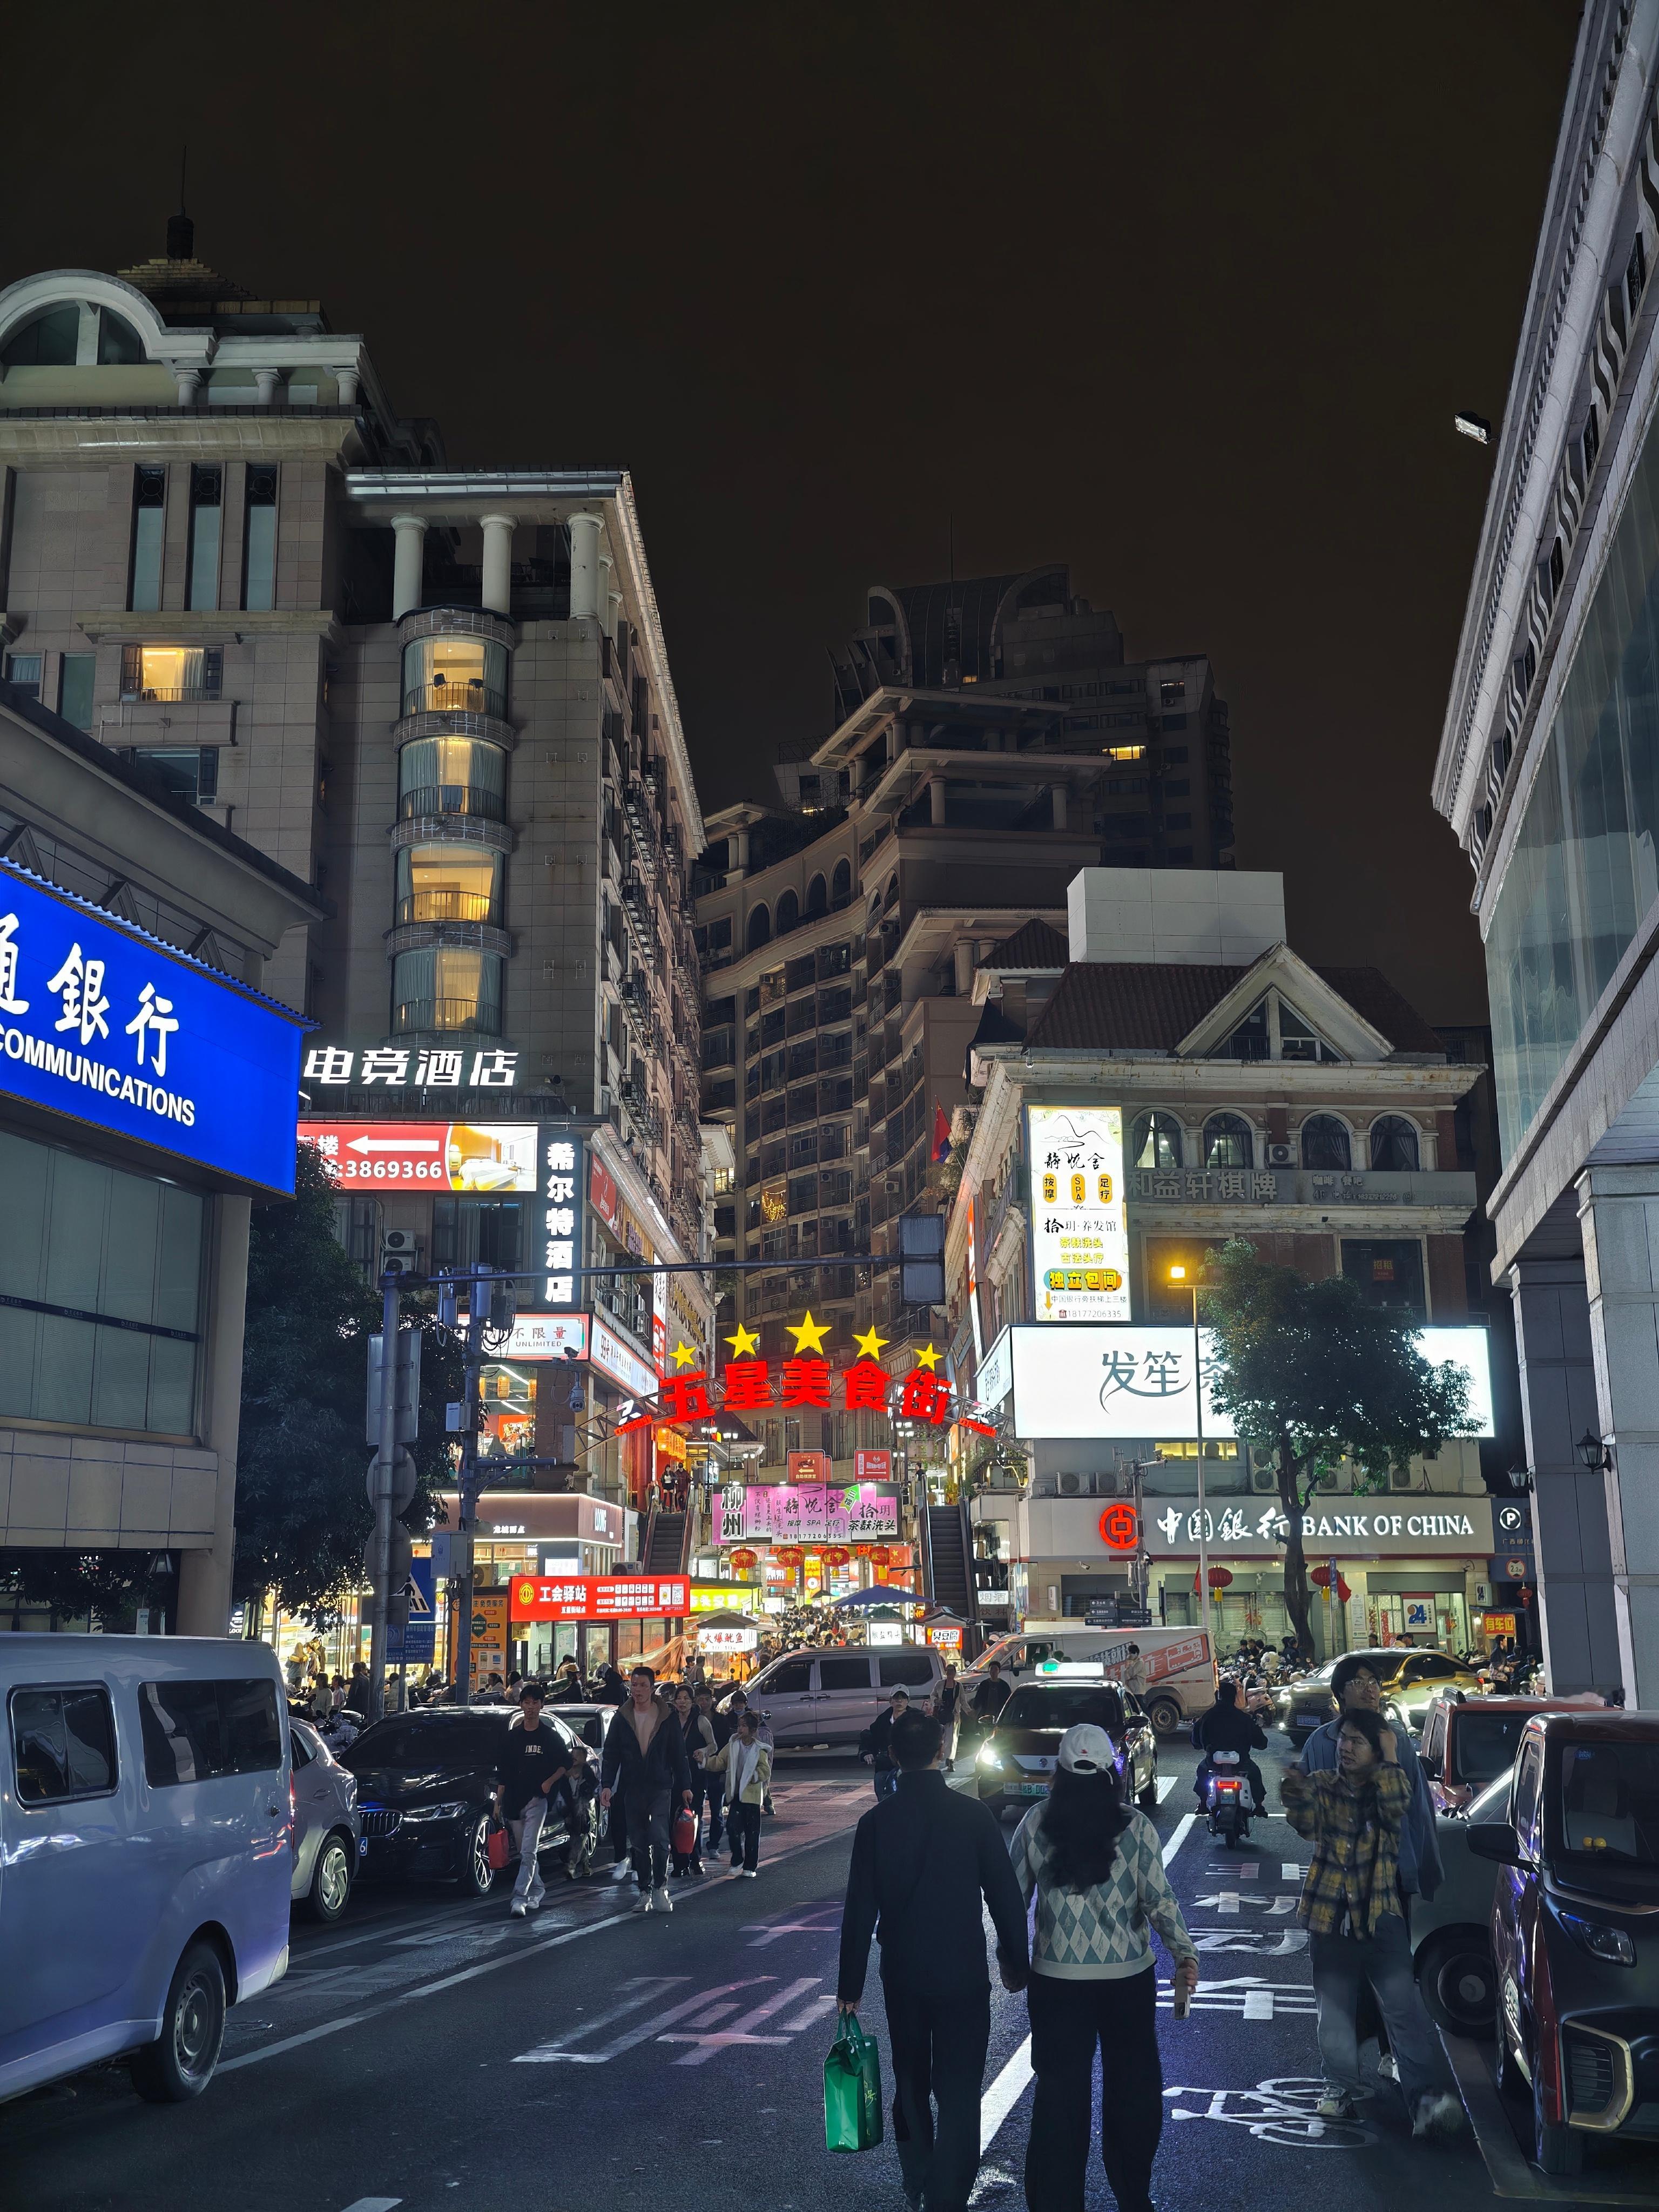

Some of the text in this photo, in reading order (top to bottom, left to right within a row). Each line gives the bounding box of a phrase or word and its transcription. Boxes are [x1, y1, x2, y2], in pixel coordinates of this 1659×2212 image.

[0, 1022, 195, 1127] OMMUNICATIONS
[304, 1046, 518, 1086] 电竞酒店
[1044, 1177, 1055, 1199] 按摩
[1100, 1178, 1110, 1199] 足疗
[545, 1142, 575, 1303] 希尔特酒店
[1061, 1253, 1104, 1264] 古法头疗
[1374, 1259, 1393, 1270] 招租
[1049, 1271, 1117, 1290] 独立包间
[660, 1359, 952, 1425] 五星美食街
[721, 1486, 744, 1536] 柳州
[1301, 1514, 1475, 1536] BANK OF CHINA
[539, 1584, 587, 1603] 工会驿站
[979, 1593, 1006, 1603] 烟酒
[705, 1632, 744, 1644] 火爆鱿鱼
[933, 1631, 958, 1641] 臭豆腐
